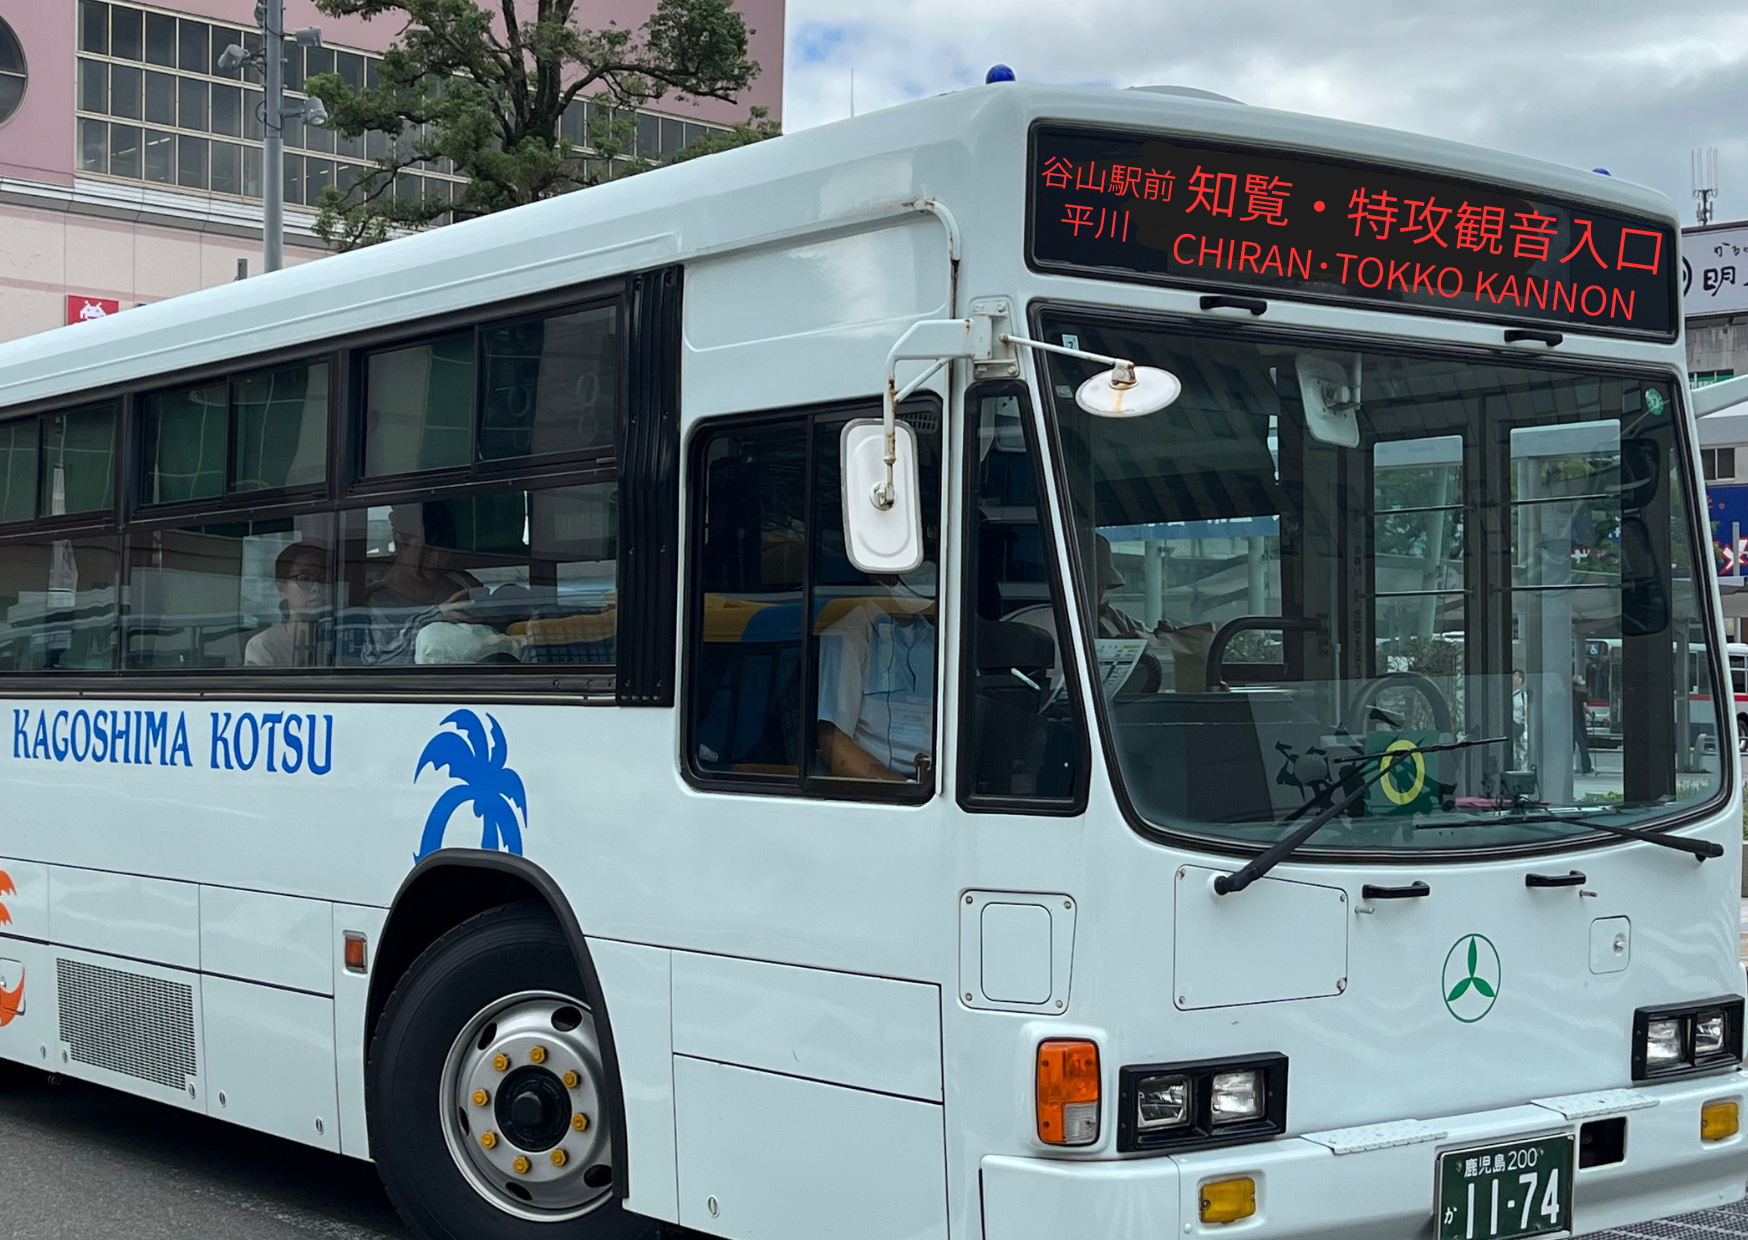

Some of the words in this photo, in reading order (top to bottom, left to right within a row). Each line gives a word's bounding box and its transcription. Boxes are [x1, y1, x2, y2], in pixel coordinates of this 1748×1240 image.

[1041, 157, 1176, 202] 谷山駅前
[1060, 203, 1130, 243] 平川
[1475, 270, 1635, 321] KANNON
[1703, 265, 1748, 297] 明
[13, 708, 193, 767] KAGOSHIMA
[210, 710, 334, 775] KOTSU
[1443, 1206, 1458, 1225] か
